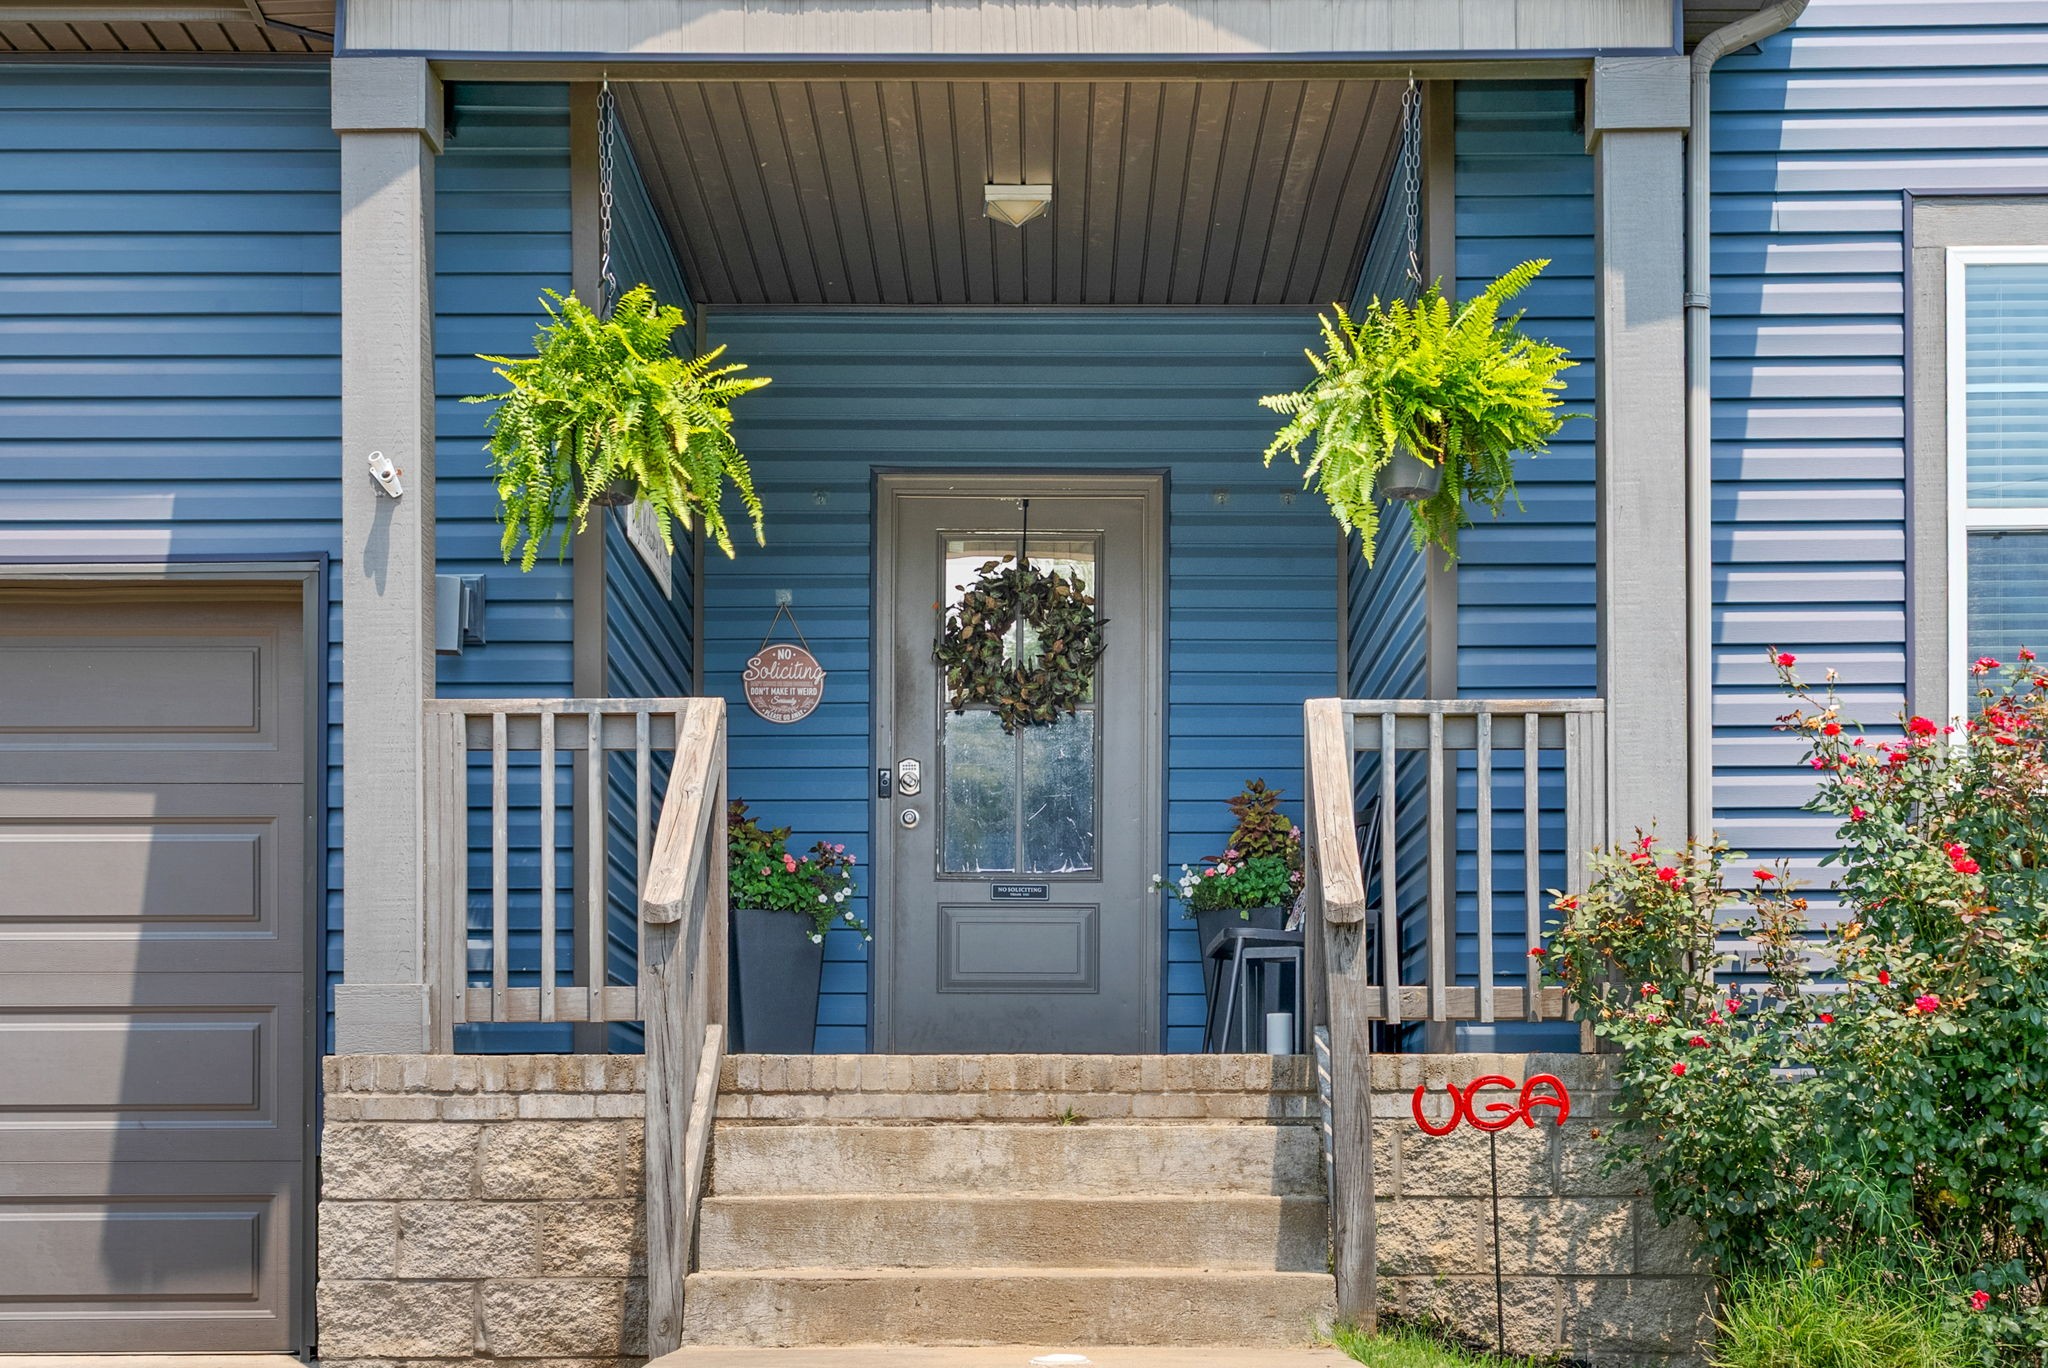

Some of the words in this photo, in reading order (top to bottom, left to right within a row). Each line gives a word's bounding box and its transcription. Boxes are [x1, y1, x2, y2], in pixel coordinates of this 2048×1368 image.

[777, 649, 791, 660] NO
[743, 657, 826, 685] Soliciting
[751, 687, 768, 695] DON'T
[771, 687, 788, 695] MAKE
[789, 687, 796, 695] IT
[797, 687, 817, 695] WEIRD
[764, 709, 782, 720] PLEASE
[1412, 1073, 1570, 1136] UGA
